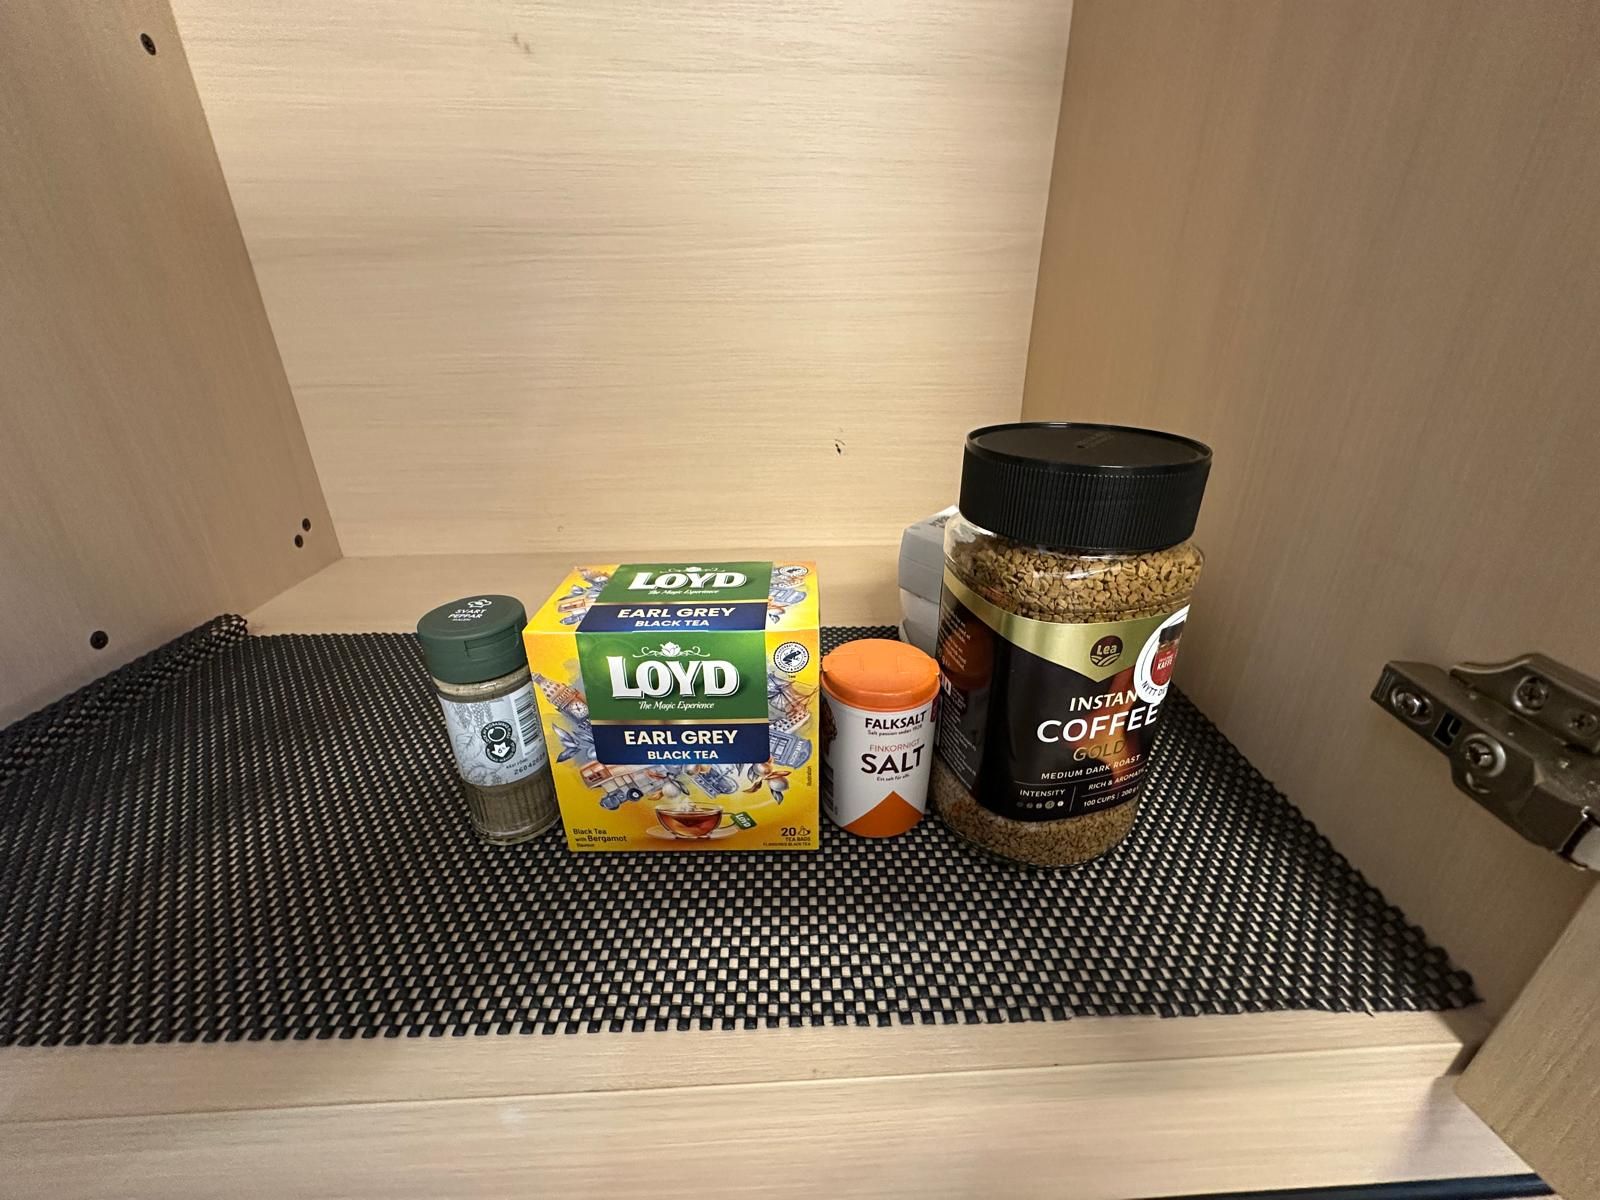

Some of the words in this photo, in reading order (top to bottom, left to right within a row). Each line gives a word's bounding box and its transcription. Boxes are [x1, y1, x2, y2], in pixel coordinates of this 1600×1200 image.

[628, 572, 748, 590] LOYD
[617, 608, 671, 618] EARL
[676, 607, 736, 617] GREY
[683, 619, 710, 627] TEA
[1096, 644, 1118, 655] Lea
[606, 655, 740, 700] LOYD
[1141, 680, 1158, 696] NYTT
[638, 700, 652, 710] The
[652, 701, 676, 712] Magic
[676, 701, 715, 711] Experience
[1069, 689, 1138, 712] INSTAN
[865, 710, 927, 730] FALKSALT
[1036, 703, 1159, 743] COFFEE
[624, 730, 677, 745] EARL
[681, 730, 738, 745] GREY
[869, 738, 920, 753] FINKORNIGT
[1073, 740, 1126, 761] GOLD
[647, 751, 691, 760] BLACK
[693, 750, 719, 760] TEA
[861, 744, 925, 775] SALT
[1041, 769, 1083, 780] MEDIUM
[1086, 763, 1112, 775] DARK
[1113, 754, 1141, 769] ROAST
[1019, 788, 1066, 798] INTENSITY
[1088, 781, 1107, 791] RICH
[1083, 799, 1096, 807] 100
[1096, 794, 1116, 804] CUPS
[587, 835, 628, 843] Bergamot
[781, 827, 797, 837] 20
